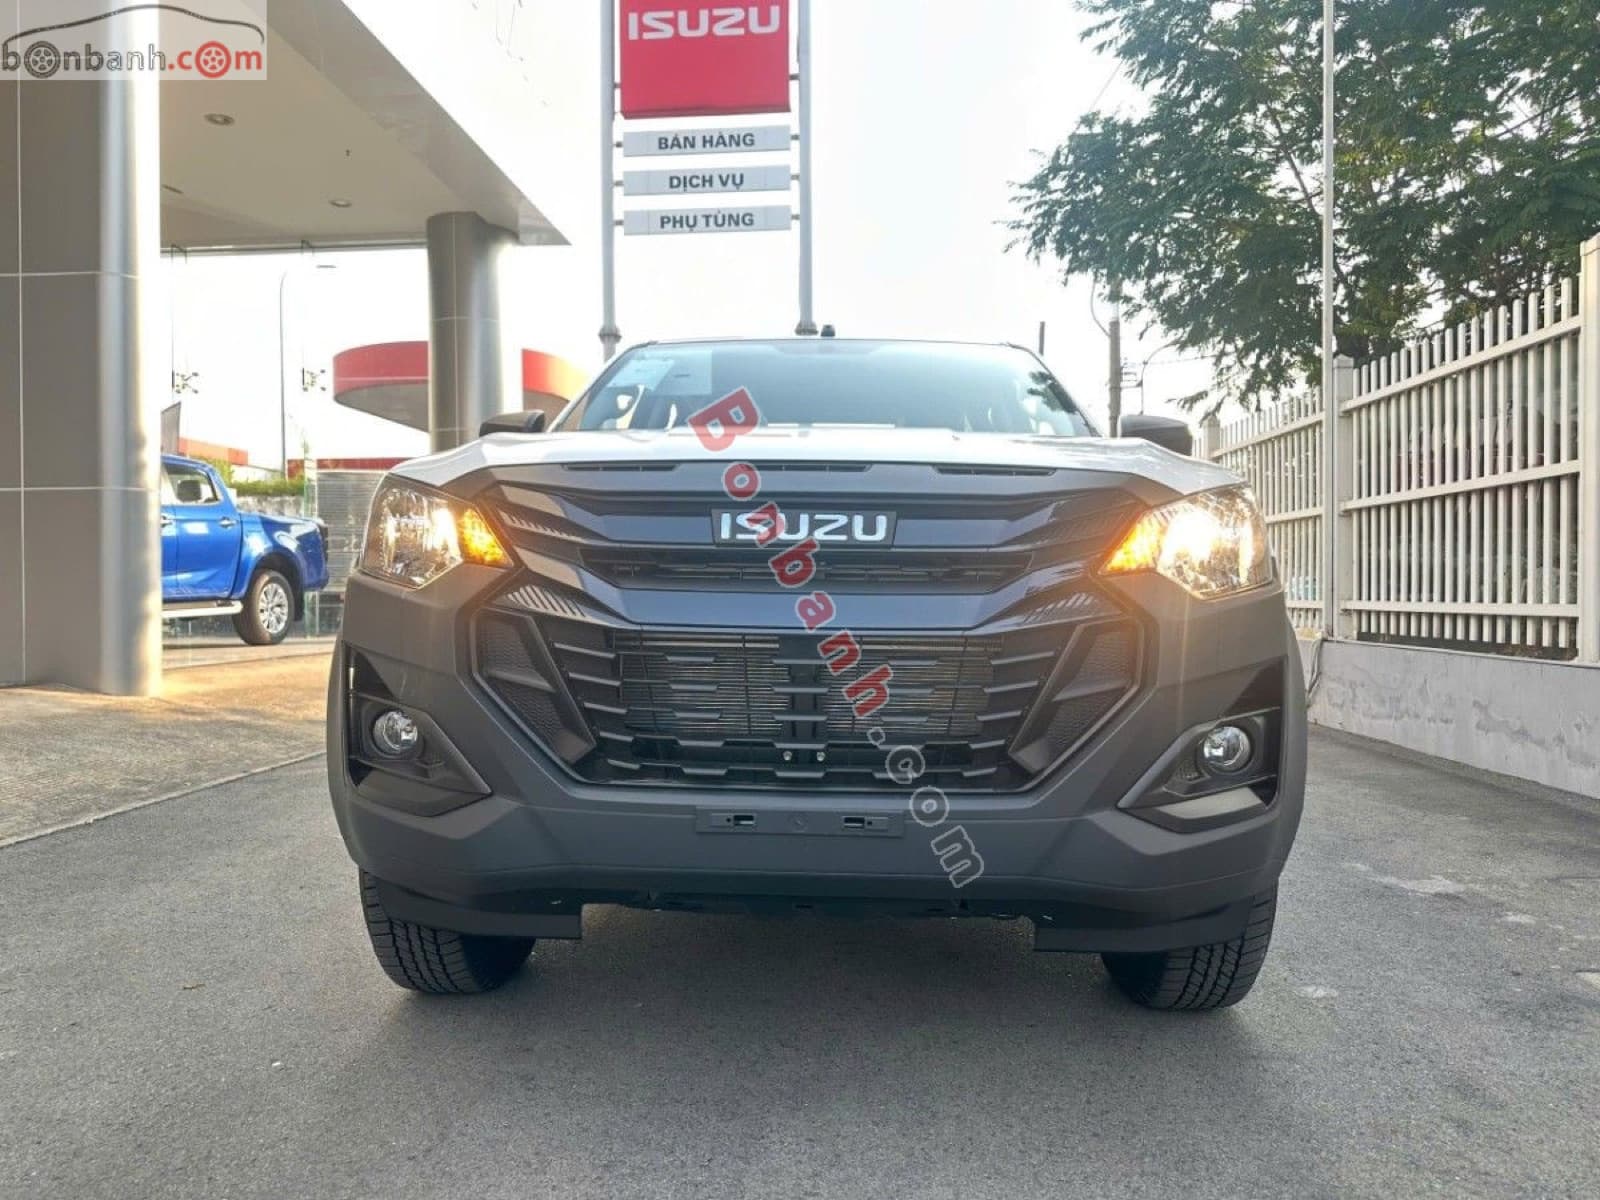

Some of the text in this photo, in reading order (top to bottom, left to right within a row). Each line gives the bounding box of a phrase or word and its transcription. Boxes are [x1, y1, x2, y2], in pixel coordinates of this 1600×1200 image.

[628, 5, 780, 40] ISUZU
[658, 131, 755, 150] BÁN HÀNG
[669, 173, 744, 192] DỊCH VỤ
[660, 210, 755, 232] PHỤ TÙNG
[720, 513, 887, 541] ISUZU
